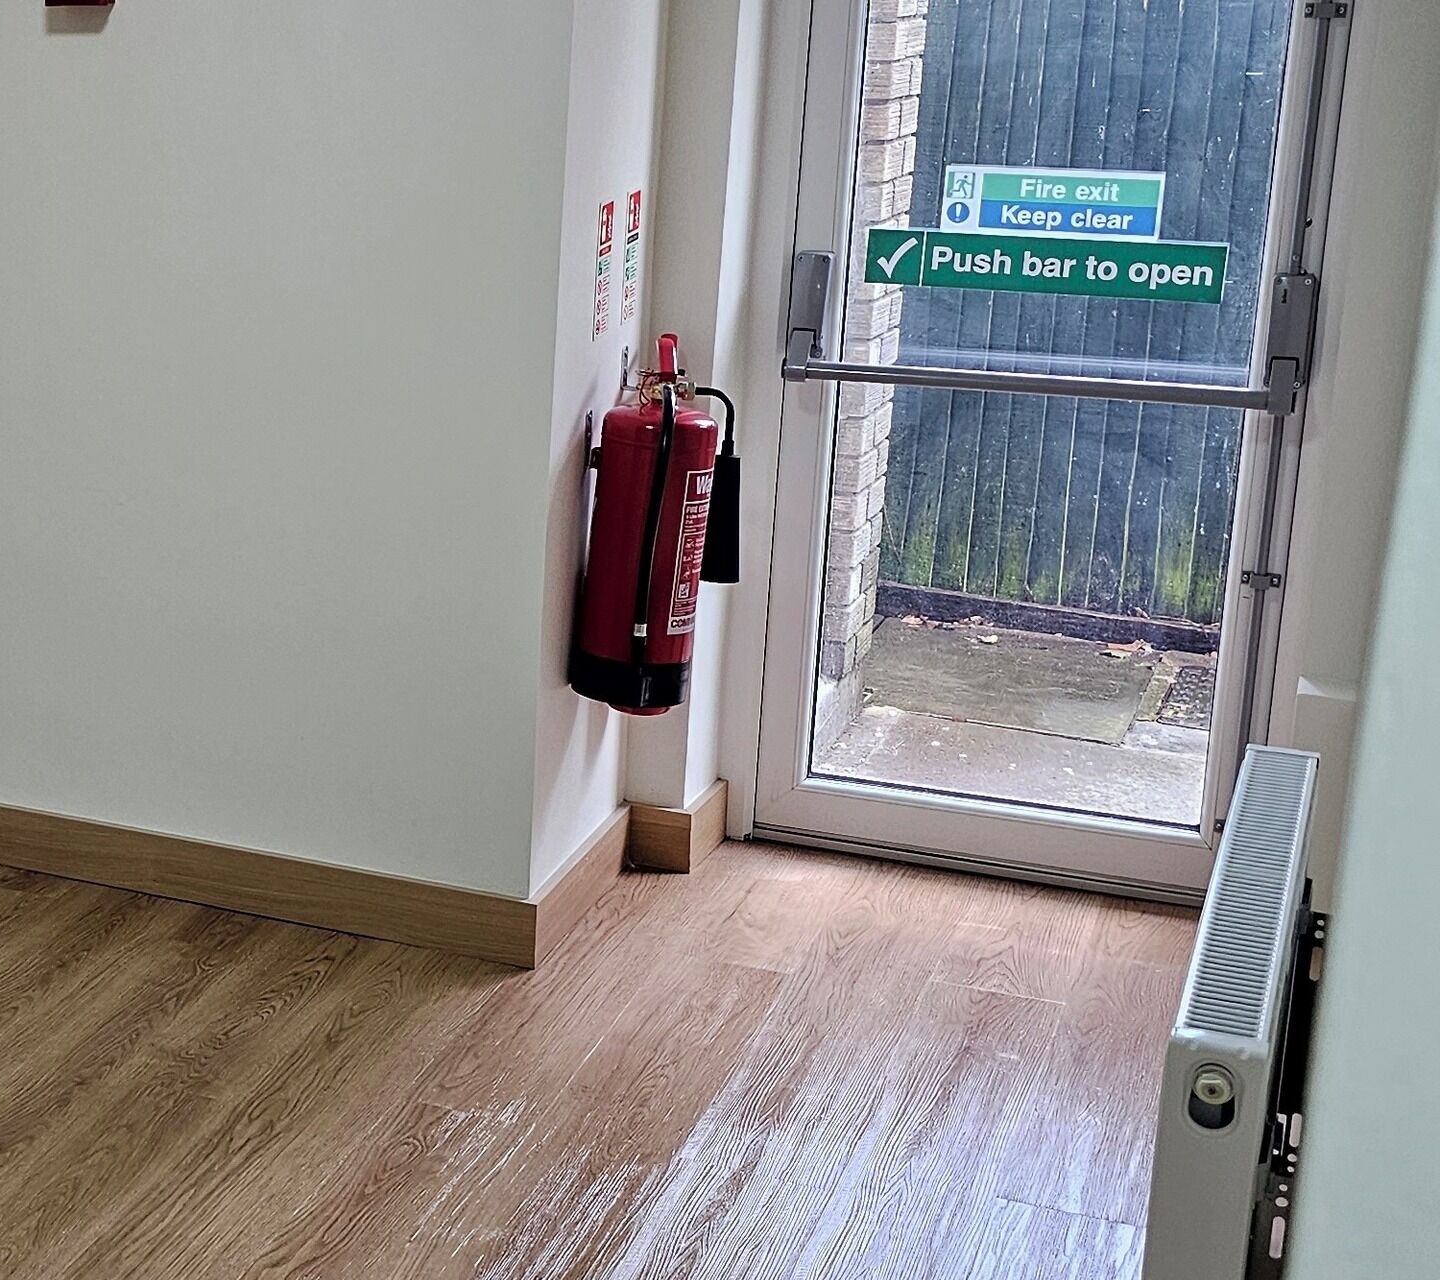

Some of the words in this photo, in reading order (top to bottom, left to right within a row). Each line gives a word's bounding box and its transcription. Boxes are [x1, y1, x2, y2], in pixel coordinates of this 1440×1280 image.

[1019, 178, 1067, 199] Fire
[1075, 181, 1120, 202] exit
[1000, 204, 1062, 230] Keep
[1070, 208, 1134, 230] clear
[930, 245, 1012, 275] Push
[1021, 250, 1076, 278] bar
[1085, 255, 1119, 281] to
[1128, 261, 1214, 290] open
